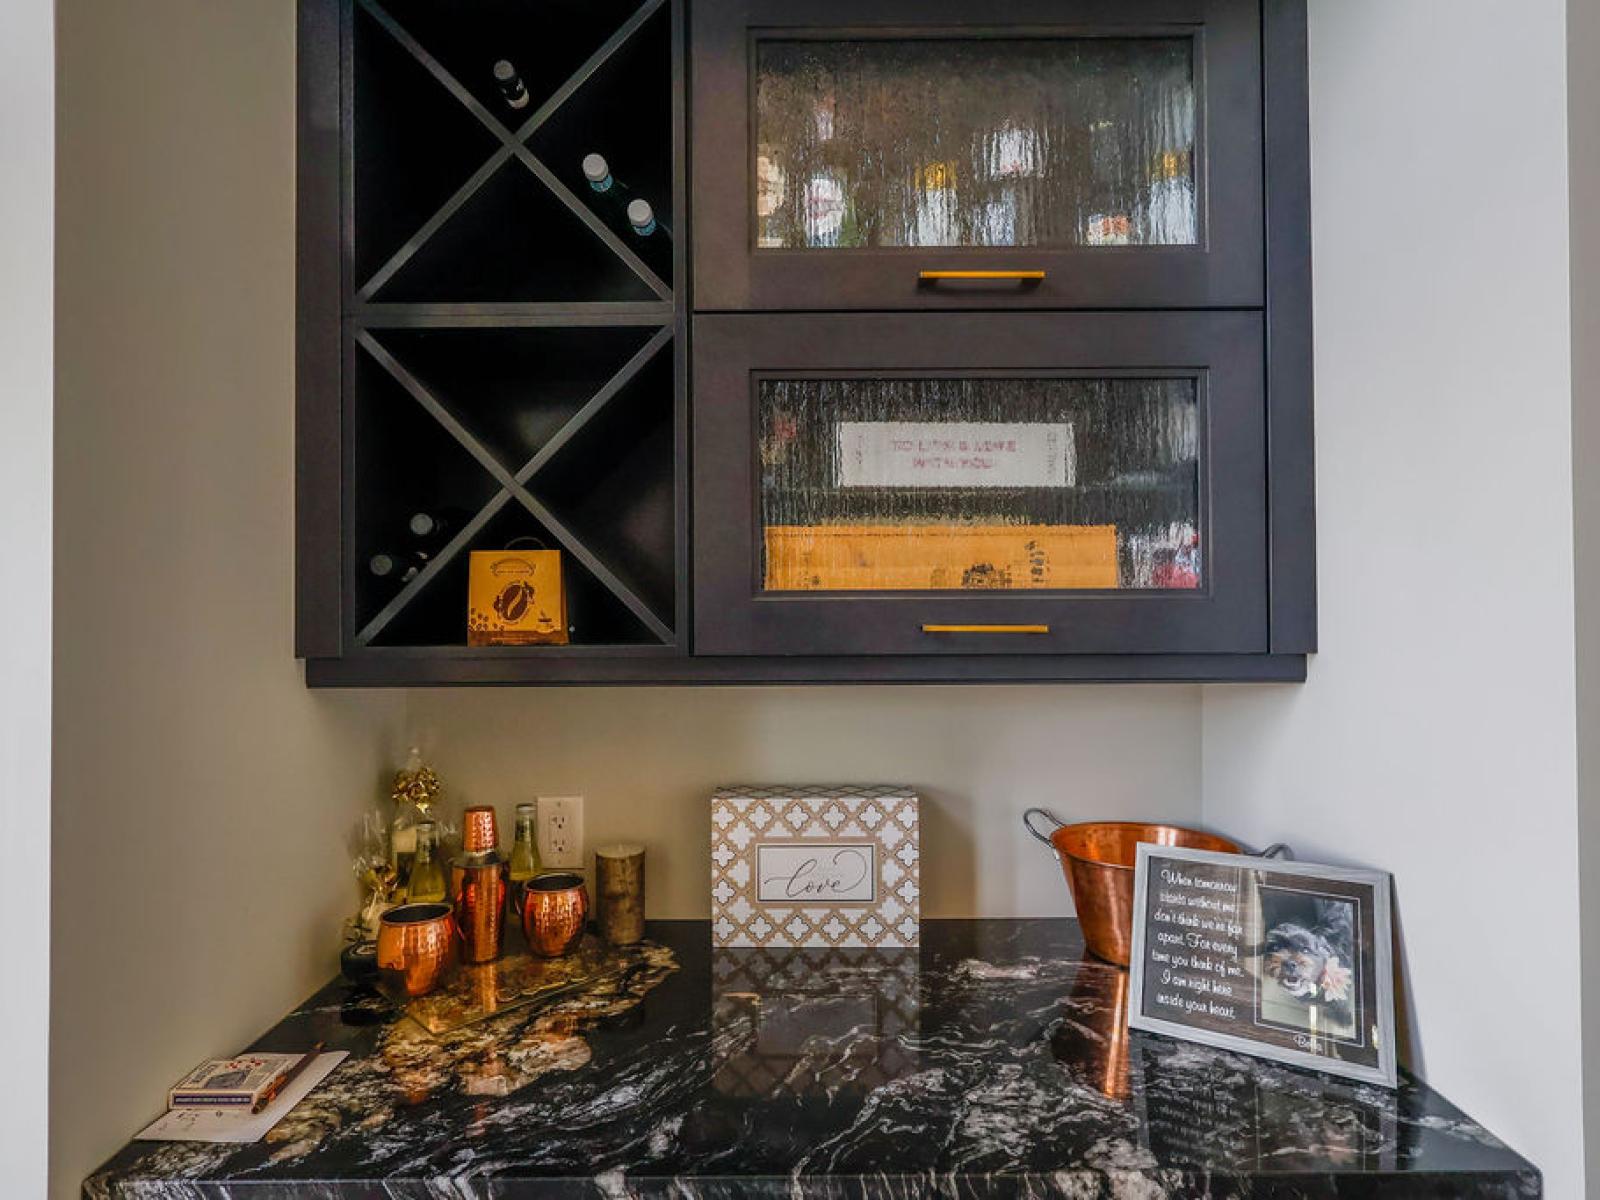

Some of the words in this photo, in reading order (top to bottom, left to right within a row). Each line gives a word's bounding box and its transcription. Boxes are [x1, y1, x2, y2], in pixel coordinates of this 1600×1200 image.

[764, 850, 867, 898] love
[1160, 869, 1192, 886] When
[1171, 956, 1189, 969] you
[1215, 960, 1226, 978] of
